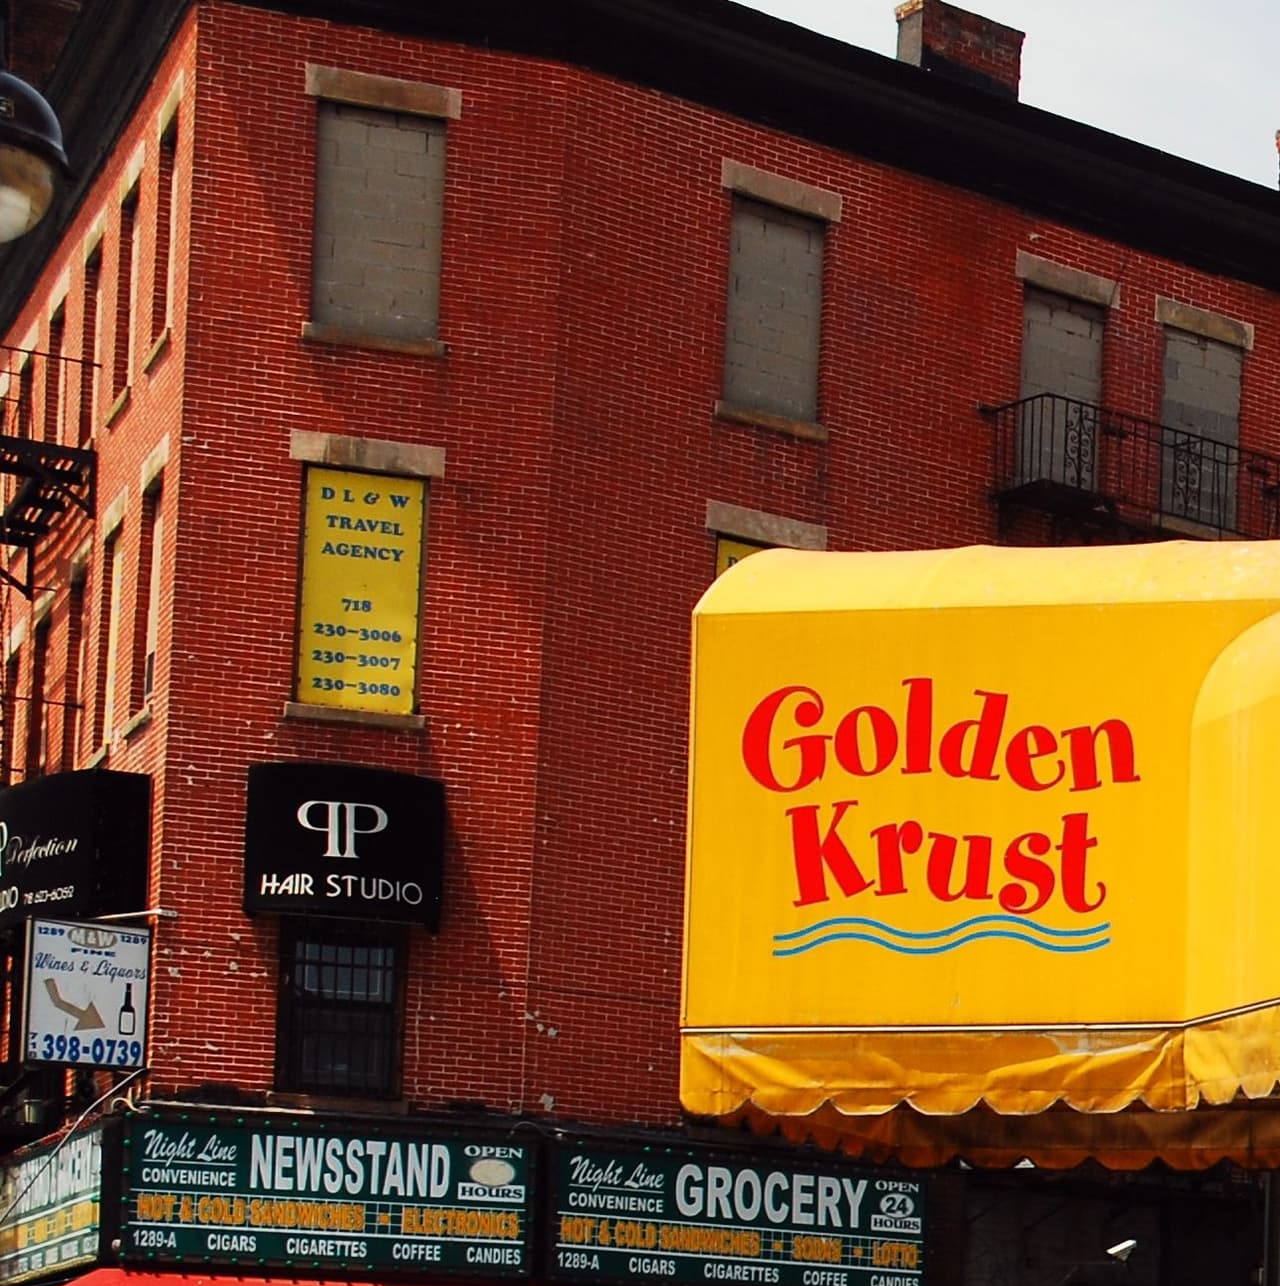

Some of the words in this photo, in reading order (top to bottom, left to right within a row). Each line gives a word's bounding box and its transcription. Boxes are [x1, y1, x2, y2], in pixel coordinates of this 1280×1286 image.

[326, 515, 404, 536] TRAVEL
[321, 542, 404, 562] AGENCY
[341, 599, 372, 613] 718
[313, 623, 402, 643] 230-3006
[312, 650, 401, 671] 230-3007
[312, 677, 401, 697] 230-3080
[742, 677, 1141, 793] Golden
[785, 799, 1107, 915] Krust
[260, 873, 314, 896] HAIR
[325, 875, 423, 905] STUDIO
[35, 952, 74, 972] Wines
[92, 959, 146, 983] Liquors
[42, 1033, 142, 1066] 398-0739
[144, 1129, 197, 1167] Night
[196, 1134, 238, 1163] Line
[464, 1144, 523, 1159] OPEN
[142, 1167, 236, 1188] CONVENIENCE
[250, 1133, 450, 1199] NEWSSTAND
[570, 1155, 624, 1192] Night
[624, 1162, 665, 1189] Line
[460, 1185, 523, 1200] HOURS
[675, 1163, 868, 1229] GROCERY
[875, 1179, 920, 1193] OPEN
[568, 1192, 664, 1213] CONVENIENCE
[883, 1196, 909, 1214] 24
[137, 1193, 177, 1222] HOT
[180, 1196, 194, 1223] &
[198, 1196, 246, 1225] COLD
[250, 1199, 365, 1233] SANDWICHES
[402, 1206, 520, 1240] ELECTRONICS
[872, 1217, 920, 1230] HOURS
[133, 1229, 177, 1249] 1289-A
[207, 1234, 257, 1252] CIGARS
[286, 1238, 367, 1258] CIGARETTES
[392, 1243, 441, 1261] COFFEE
[466, 1247, 521, 1265] CANDIES
[560, 1215, 595, 1244] HOT
[598, 1218, 611, 1246] &
[615, 1220, 657, 1249] COLD
[660, 1224, 761, 1257] SANDWICHES
[792, 1235, 842, 1264] SODAS
[872, 1241, 919, 1269] LOTTO
[557, 1251, 600, 1270] 1289-A
[628, 1257, 676, 1276] CIGARS
[704, 1263, 780, 1284] CIGARETTES
